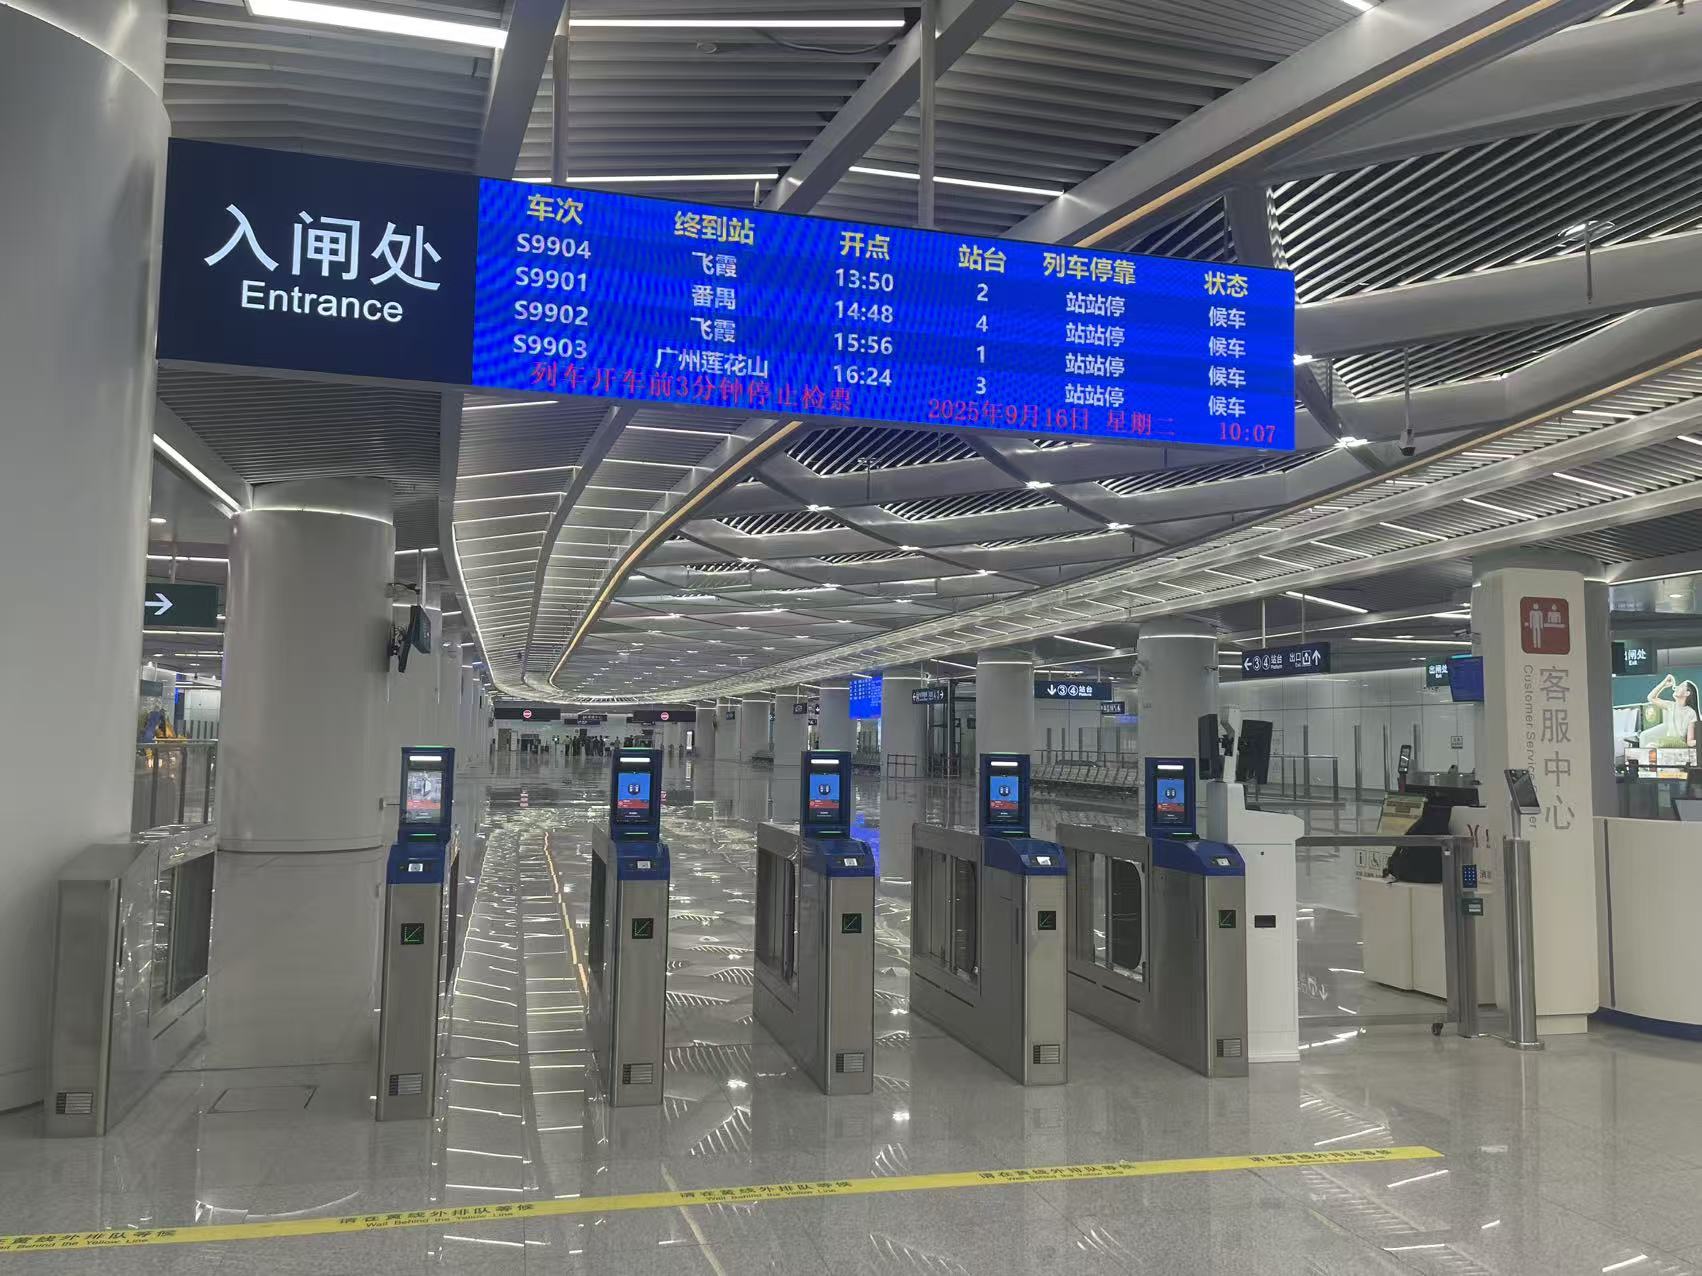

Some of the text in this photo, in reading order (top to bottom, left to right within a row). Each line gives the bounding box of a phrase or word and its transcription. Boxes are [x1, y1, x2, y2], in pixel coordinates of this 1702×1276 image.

[203, 203, 442, 291] 入闸处
[516, 233, 1246, 330] S9904 飞霞 13:50 2 站站停 候车
[527, 194, 1249, 298] 车次 终到站 开点 站台 列车停靠 状态
[241, 280, 403, 323] Entrance
[514, 300, 1246, 388] S9902 飞霞 15:56 1 站站停 候车
[515, 266, 1246, 359] S9901 番禺 14:48 4 站站停 候车
[513, 334, 1246, 418] S9903 广州莲花山 16:24 3 站站停 候车
[531, 361, 850, 412] 列车开车前3分钟停止检票
[928, 398, 1276, 444] 2025年9月16日 星期二 10:07
[1523, 664, 1534, 727] Customer
[1539, 665, 1575, 830] 客服中心
